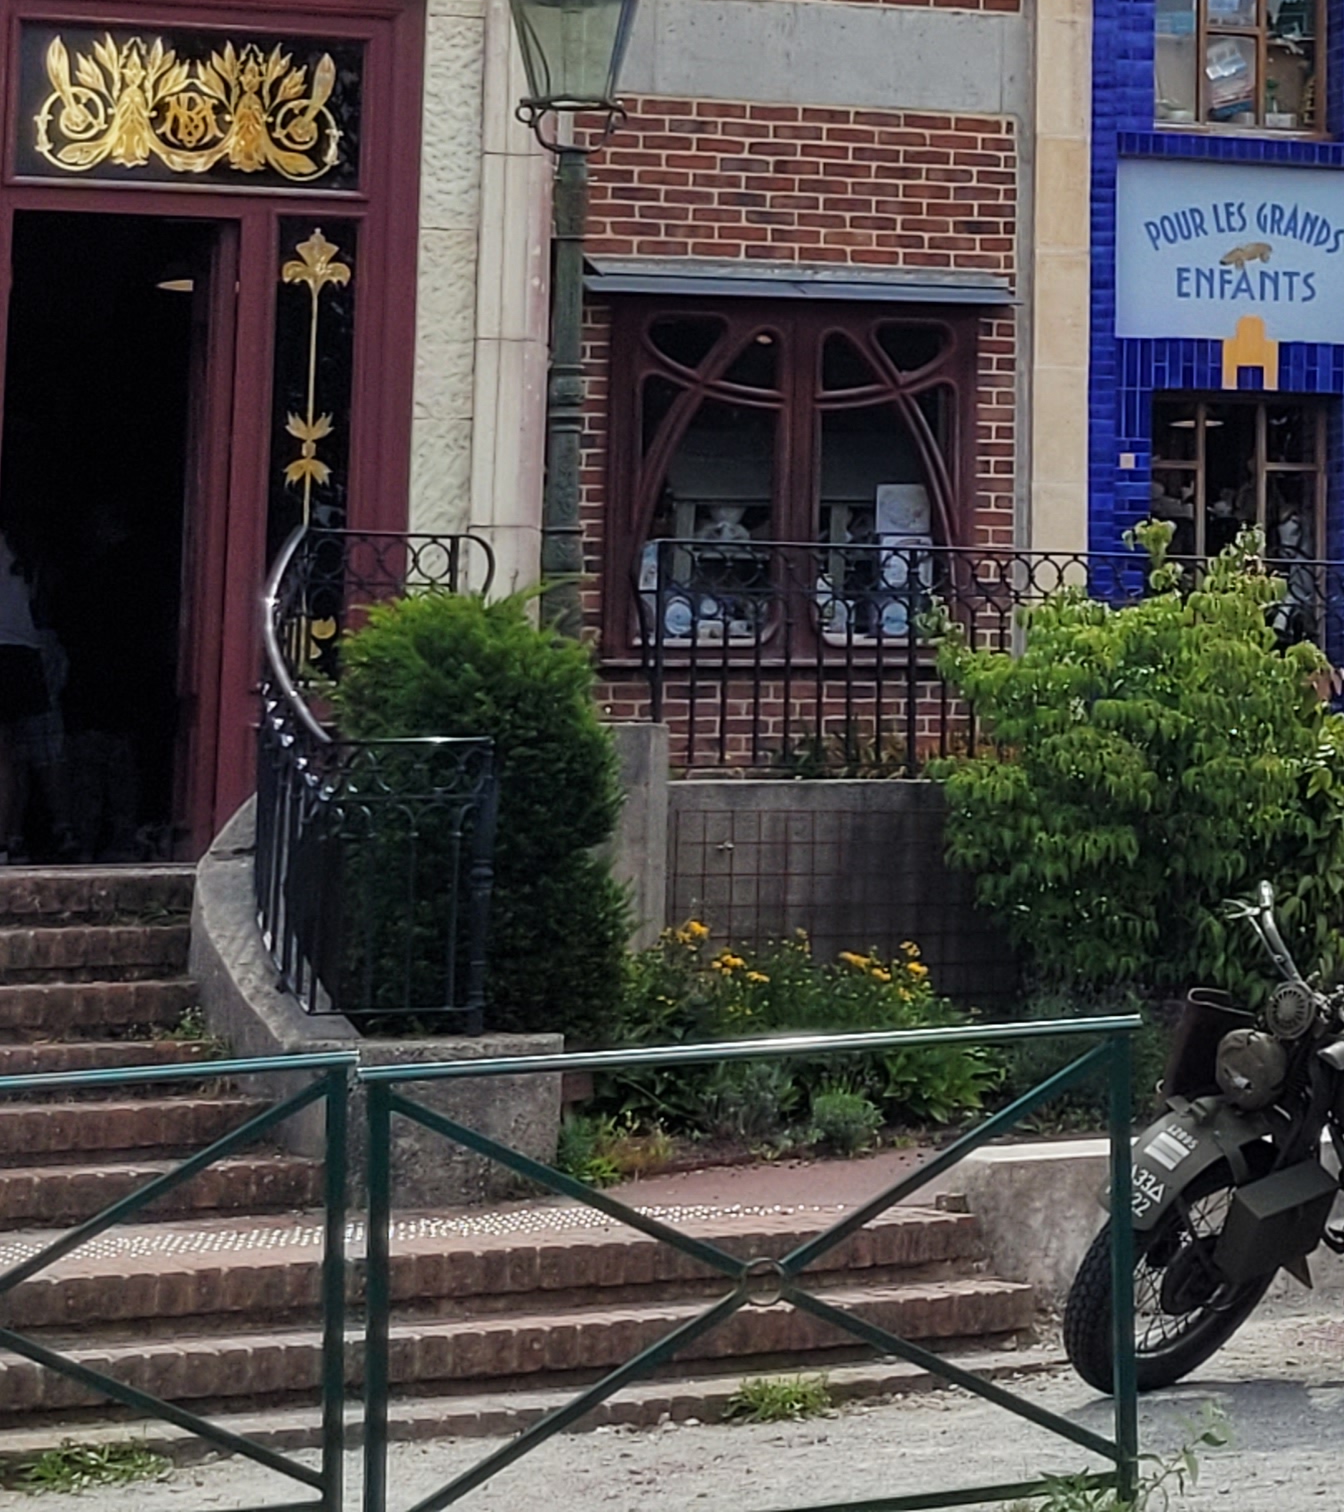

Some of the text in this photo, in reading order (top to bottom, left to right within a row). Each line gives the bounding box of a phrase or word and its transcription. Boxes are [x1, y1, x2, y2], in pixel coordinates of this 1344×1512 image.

[1144, 206, 1209, 251] POUR
[1212, 201, 1247, 233] LES
[1175, 267, 1317, 303] ENFANTS
